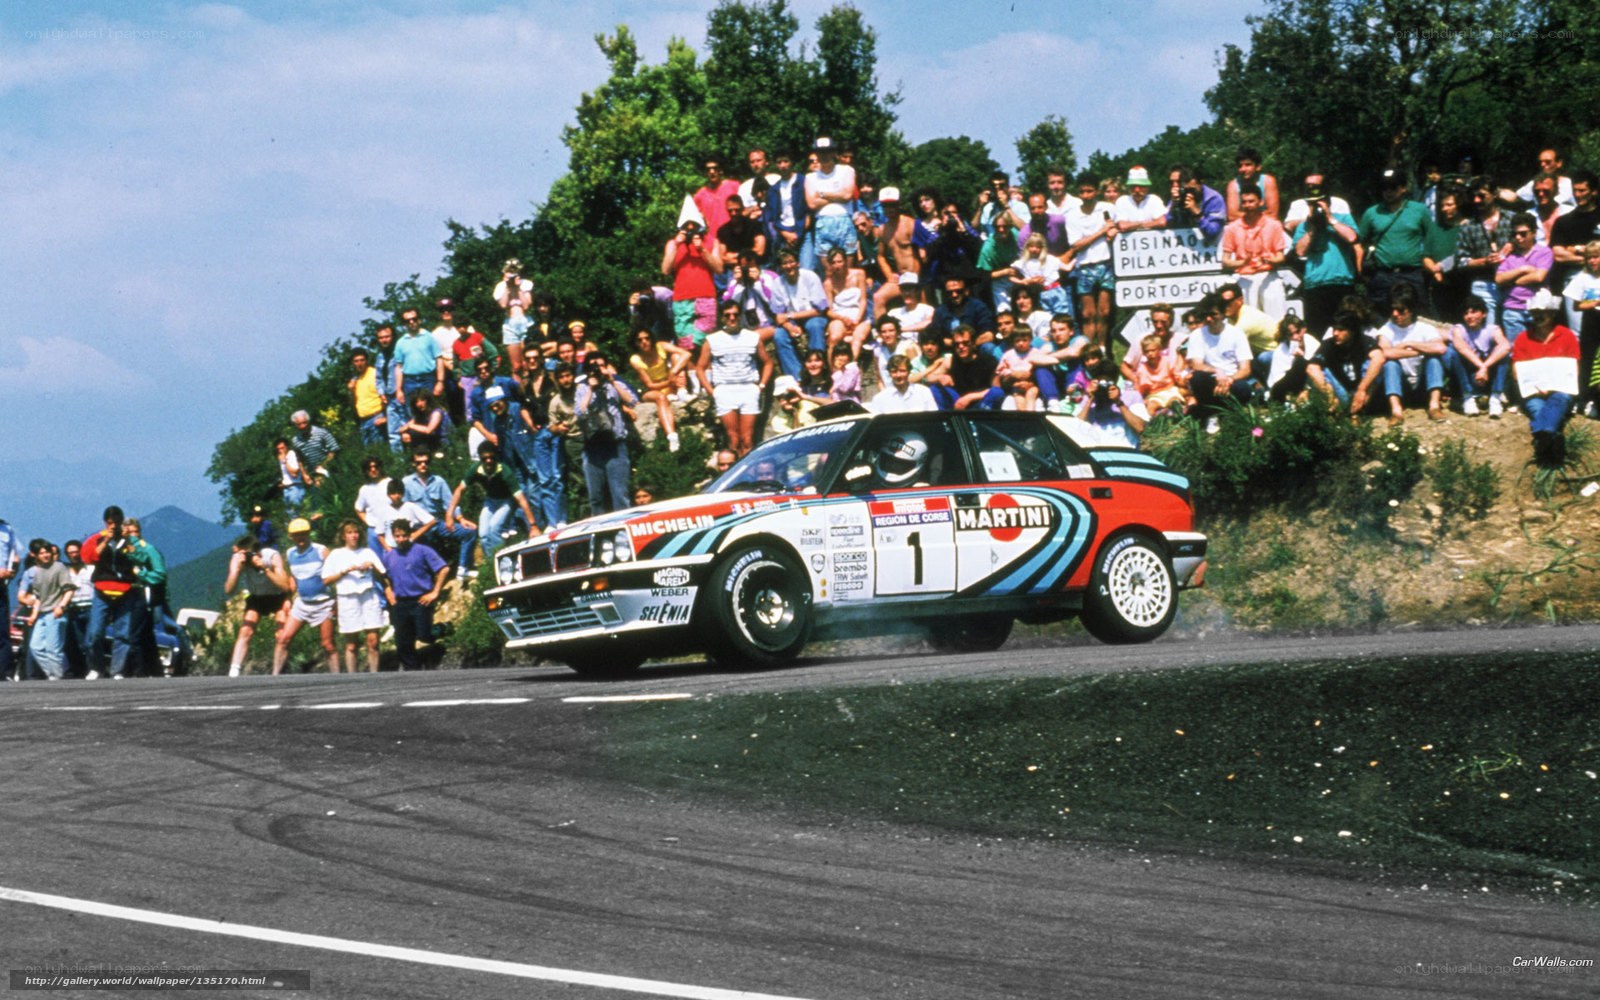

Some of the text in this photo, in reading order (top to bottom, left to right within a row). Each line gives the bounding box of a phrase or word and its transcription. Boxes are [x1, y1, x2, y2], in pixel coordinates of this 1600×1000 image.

[630, 514, 715, 537] MICHELIN
[875, 512, 950, 527] REGION DE CORSE
[958, 507, 1049, 529] MARTINI
[833, 563, 868, 573] brembo
[907, 531, 923, 585] 1
[724, 550, 763, 592] MICHELIN
[651, 588, 689, 597] WEBER
